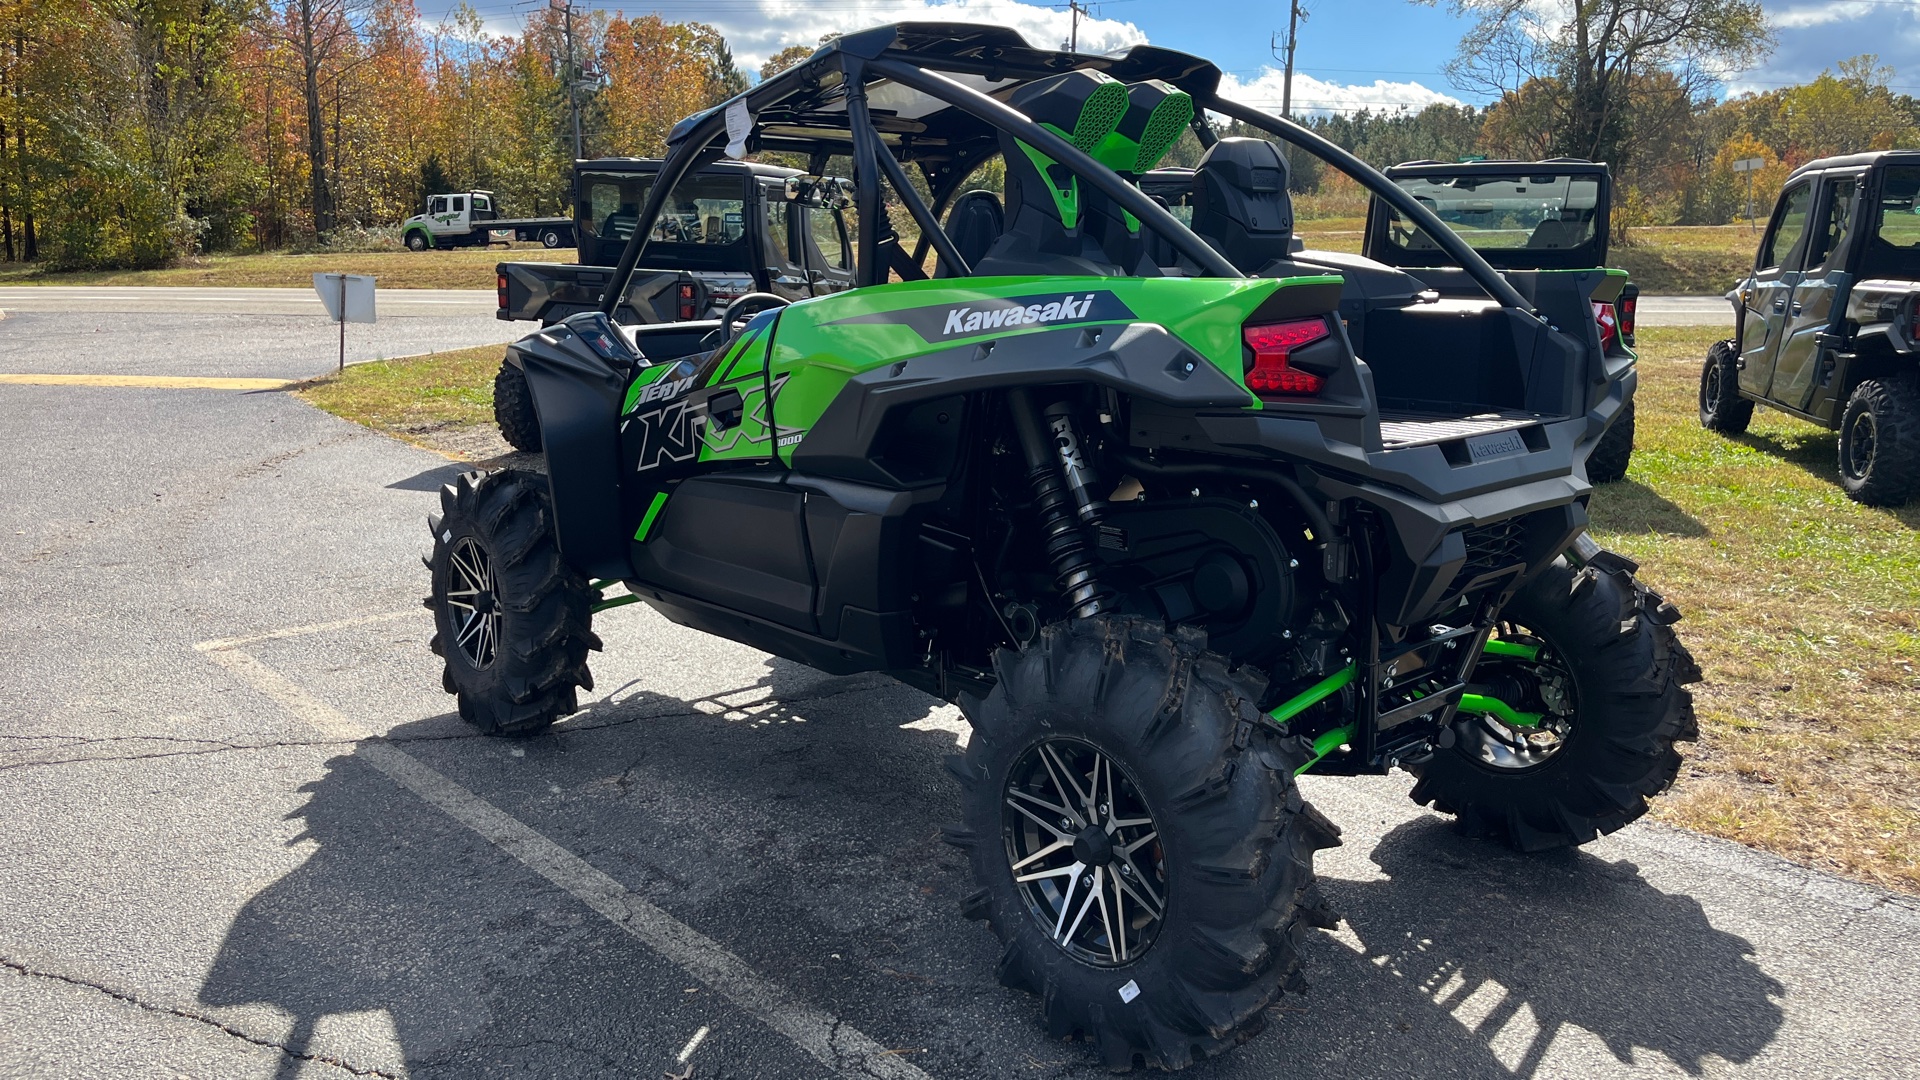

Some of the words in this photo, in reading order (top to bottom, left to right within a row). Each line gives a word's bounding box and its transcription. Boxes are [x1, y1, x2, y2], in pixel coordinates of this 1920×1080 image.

[943, 294, 1095, 335] Kawasaki
[777, 434, 803, 447] 1000
[1051, 415, 1086, 476] FOX
[1469, 435, 1522, 458] Kawasaki
